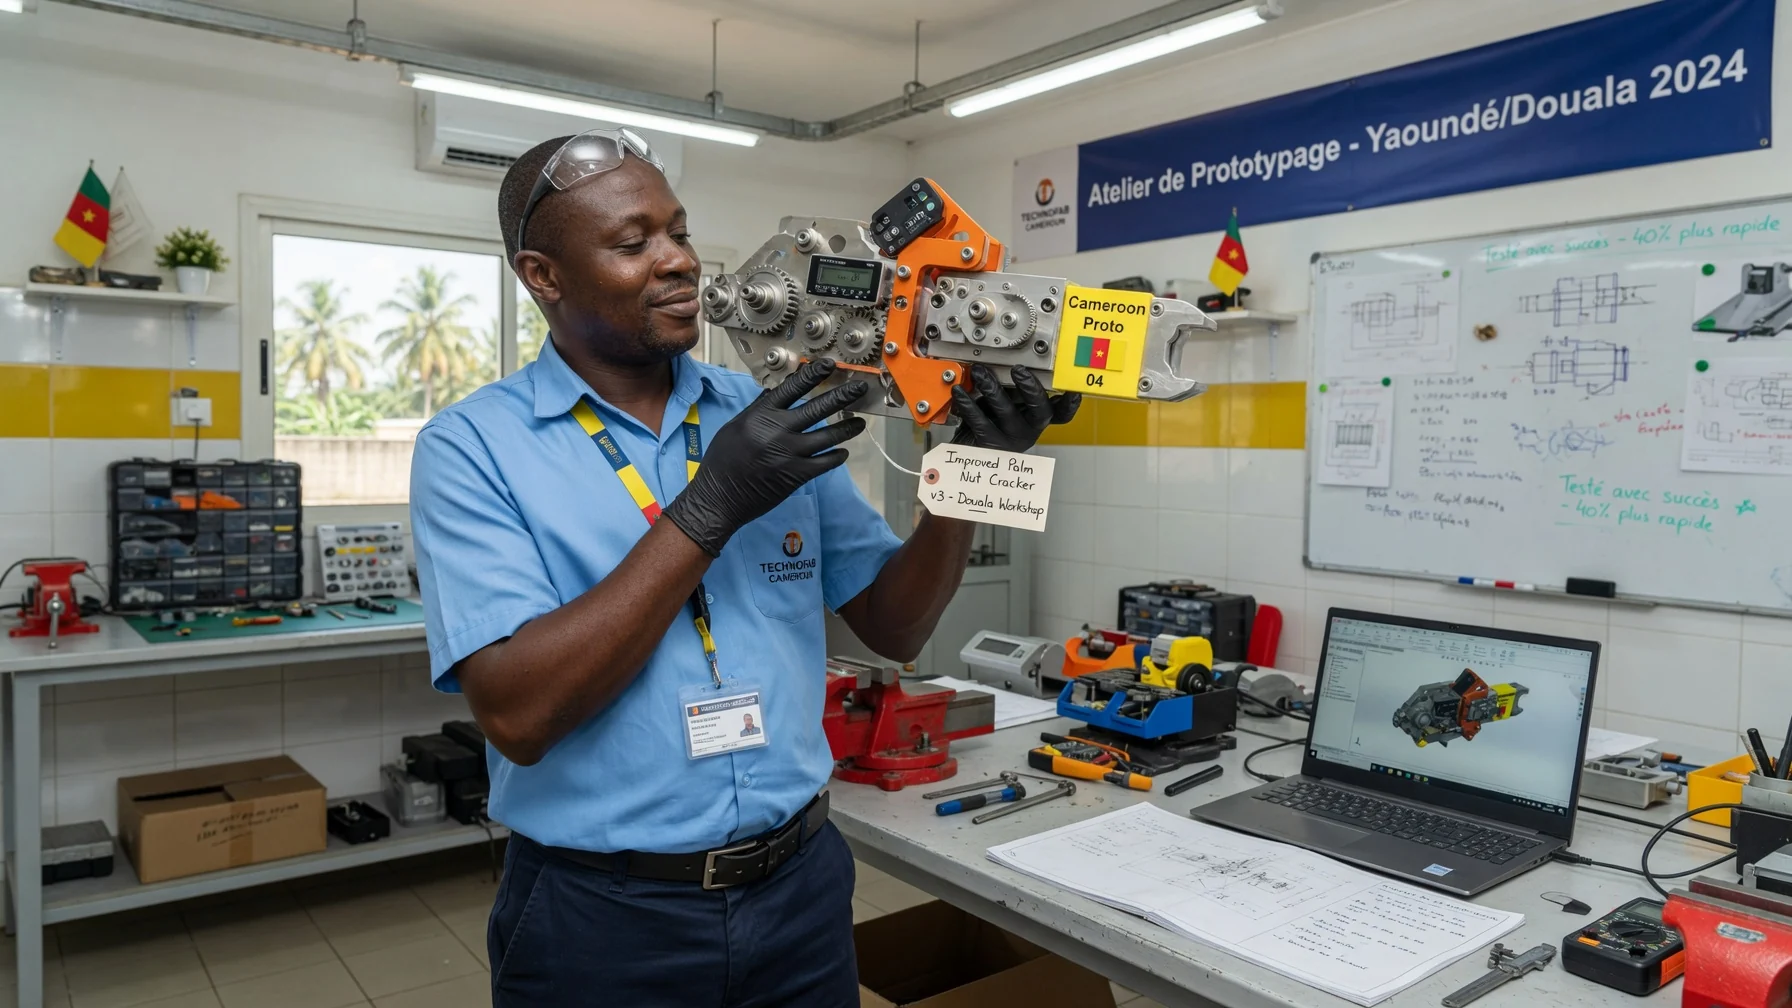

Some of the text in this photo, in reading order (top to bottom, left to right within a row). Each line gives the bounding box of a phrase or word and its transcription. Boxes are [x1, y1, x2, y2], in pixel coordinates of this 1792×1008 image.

[1087, 48, 1748, 208] Atelier de Prototypage - Yaoundé/Douala 2024
[1482, 241, 1520, 264] Testé
[1526, 244, 1554, 257] avec
[1633, 223, 1672, 245] 40%
[1679, 221, 1714, 246] plus
[1722, 214, 1781, 241] rapide
[1068, 295, 1146, 316] Cameroon
[1083, 316, 1124, 334] Proto
[1086, 373, 1104, 388] 04
[945, 450, 1034, 475] Improved Palm
[960, 471, 1036, 491] Nut Cracker
[1558, 473, 1720, 510] Testé avec succès
[930, 490, 945, 502] v3
[957, 491, 993, 508] Douala
[999, 497, 1045, 520] Workshop
[1575, 499, 1611, 519] 40%
[1618, 504, 1649, 525] plus
[1658, 514, 1713, 535] rapide
